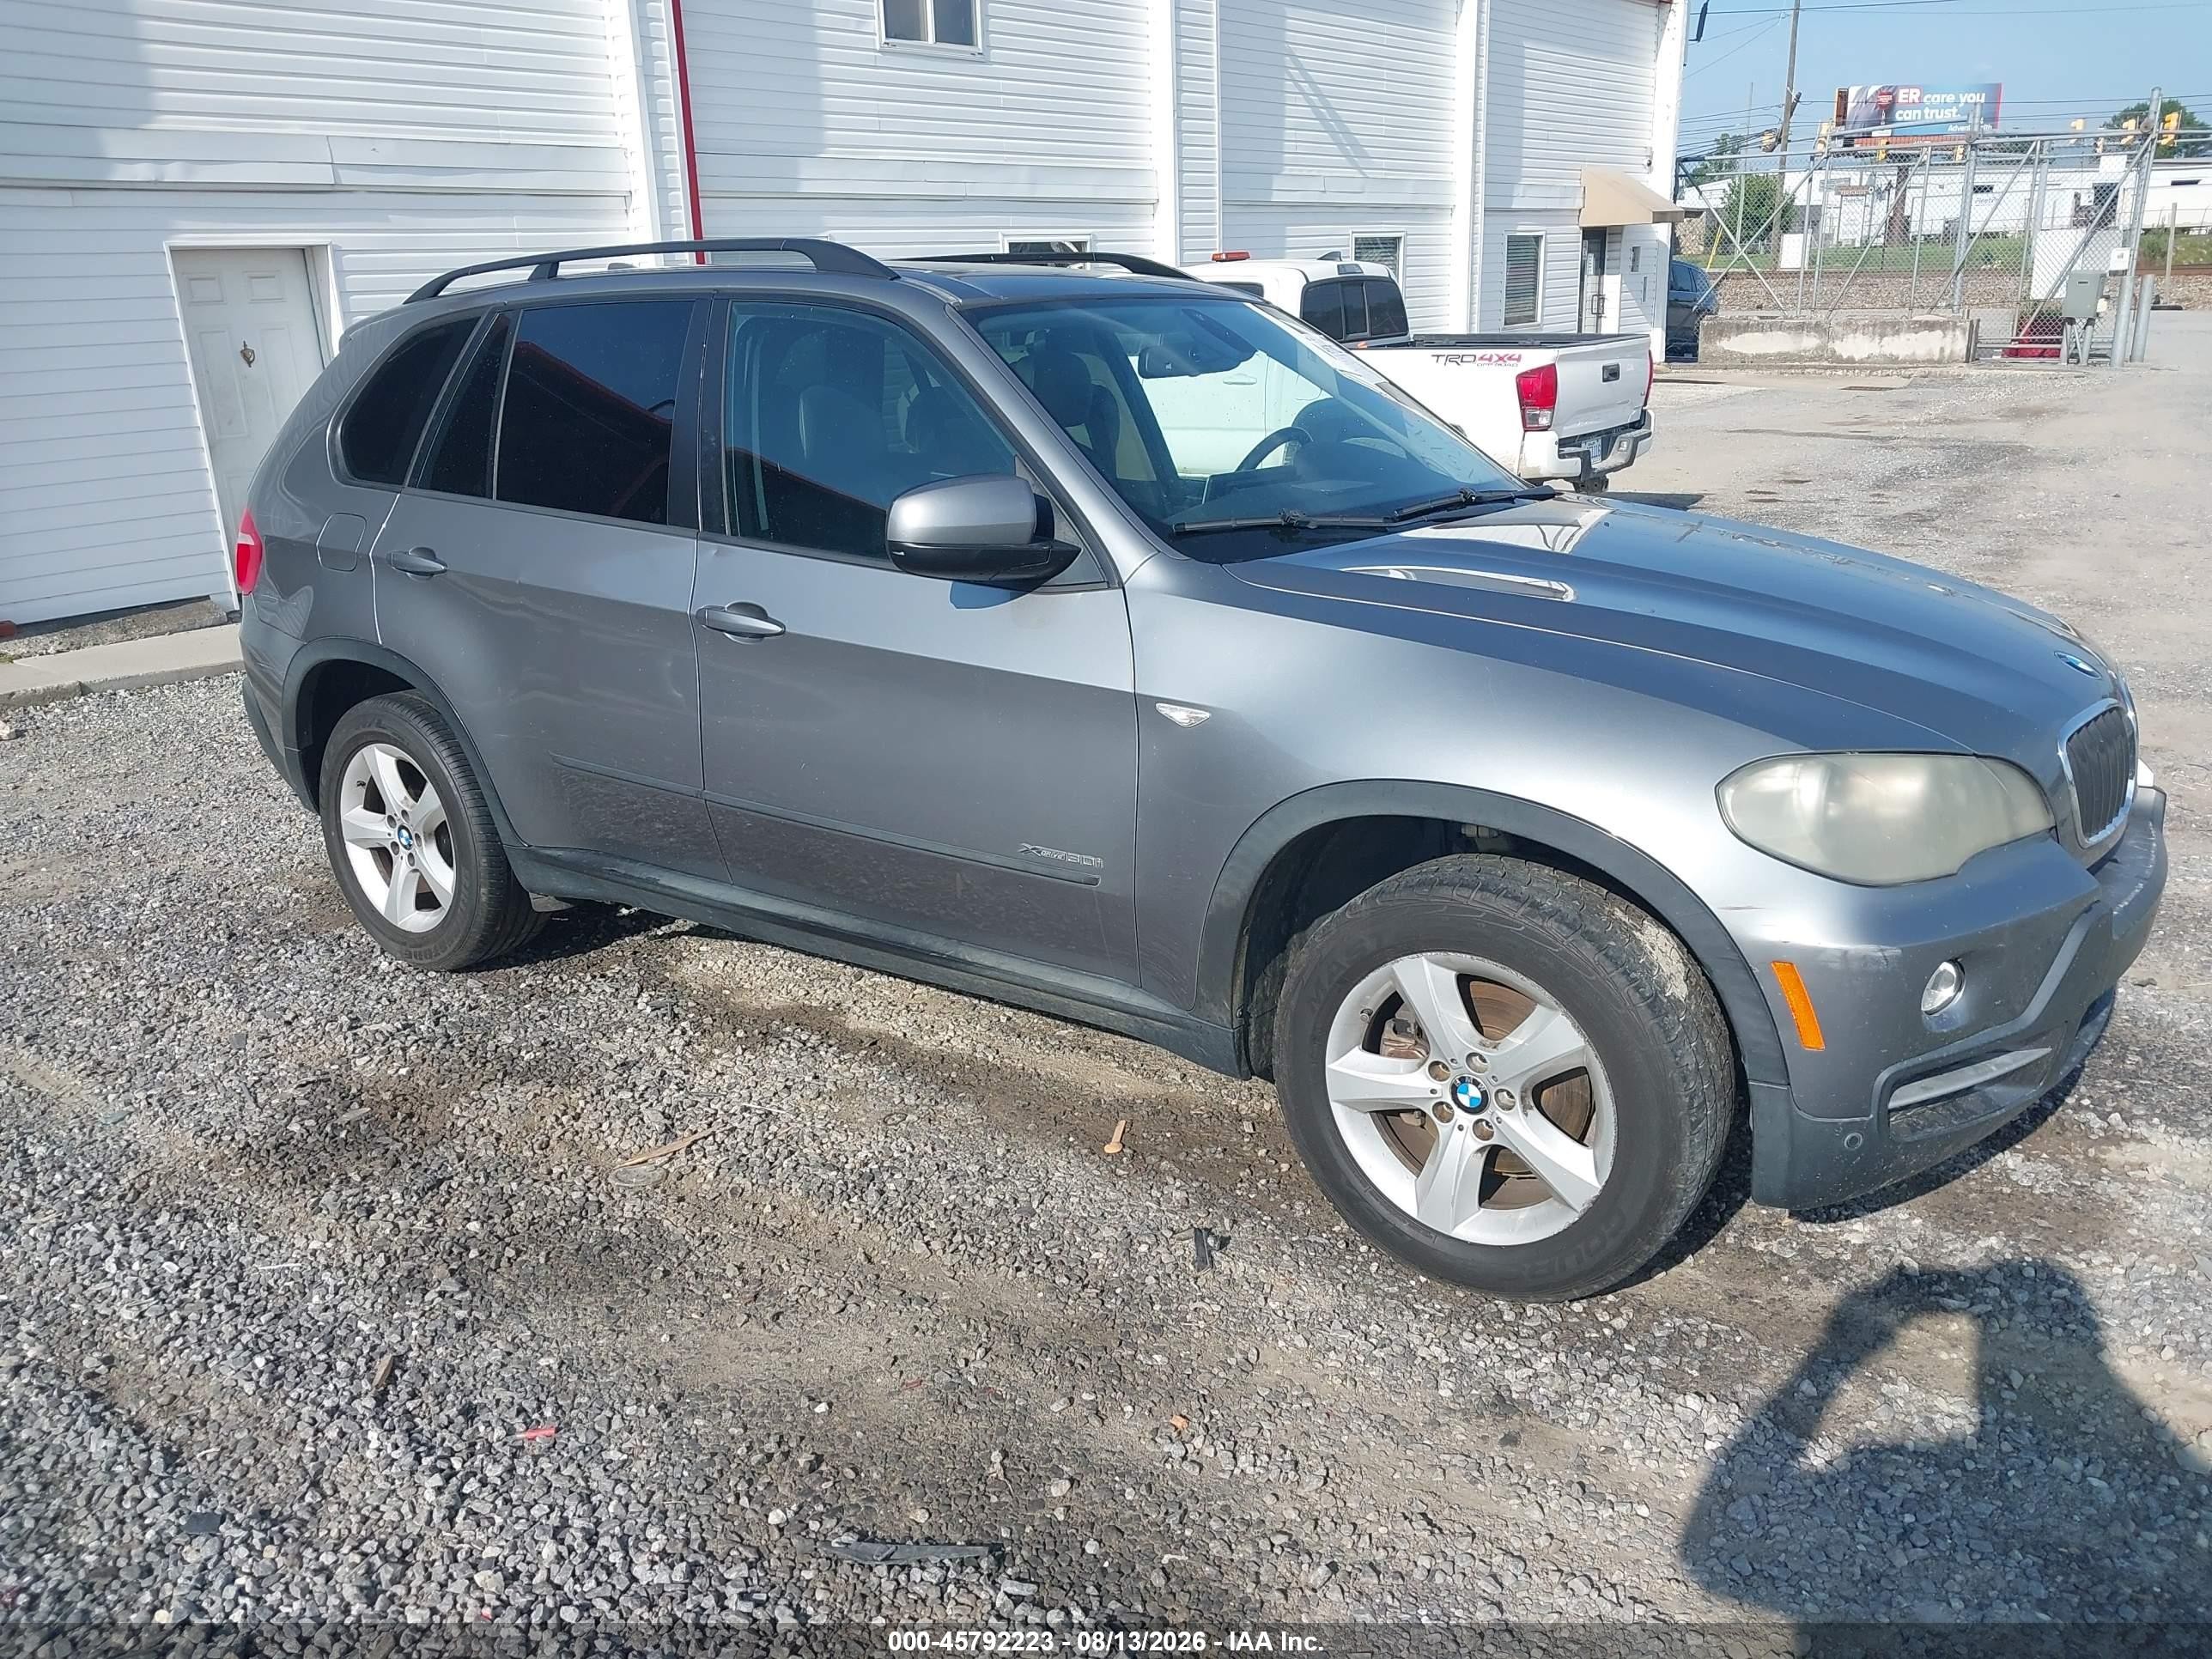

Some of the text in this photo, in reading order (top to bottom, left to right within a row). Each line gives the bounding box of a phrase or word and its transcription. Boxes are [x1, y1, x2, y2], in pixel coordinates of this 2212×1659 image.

[1898, 88, 1920, 103] ER
[1923, 93, 1955, 104] care
[1959, 92, 1985, 107] you
[1895, 106, 1960, 121] can trust.
[1431, 354, 1477, 366] TRD
